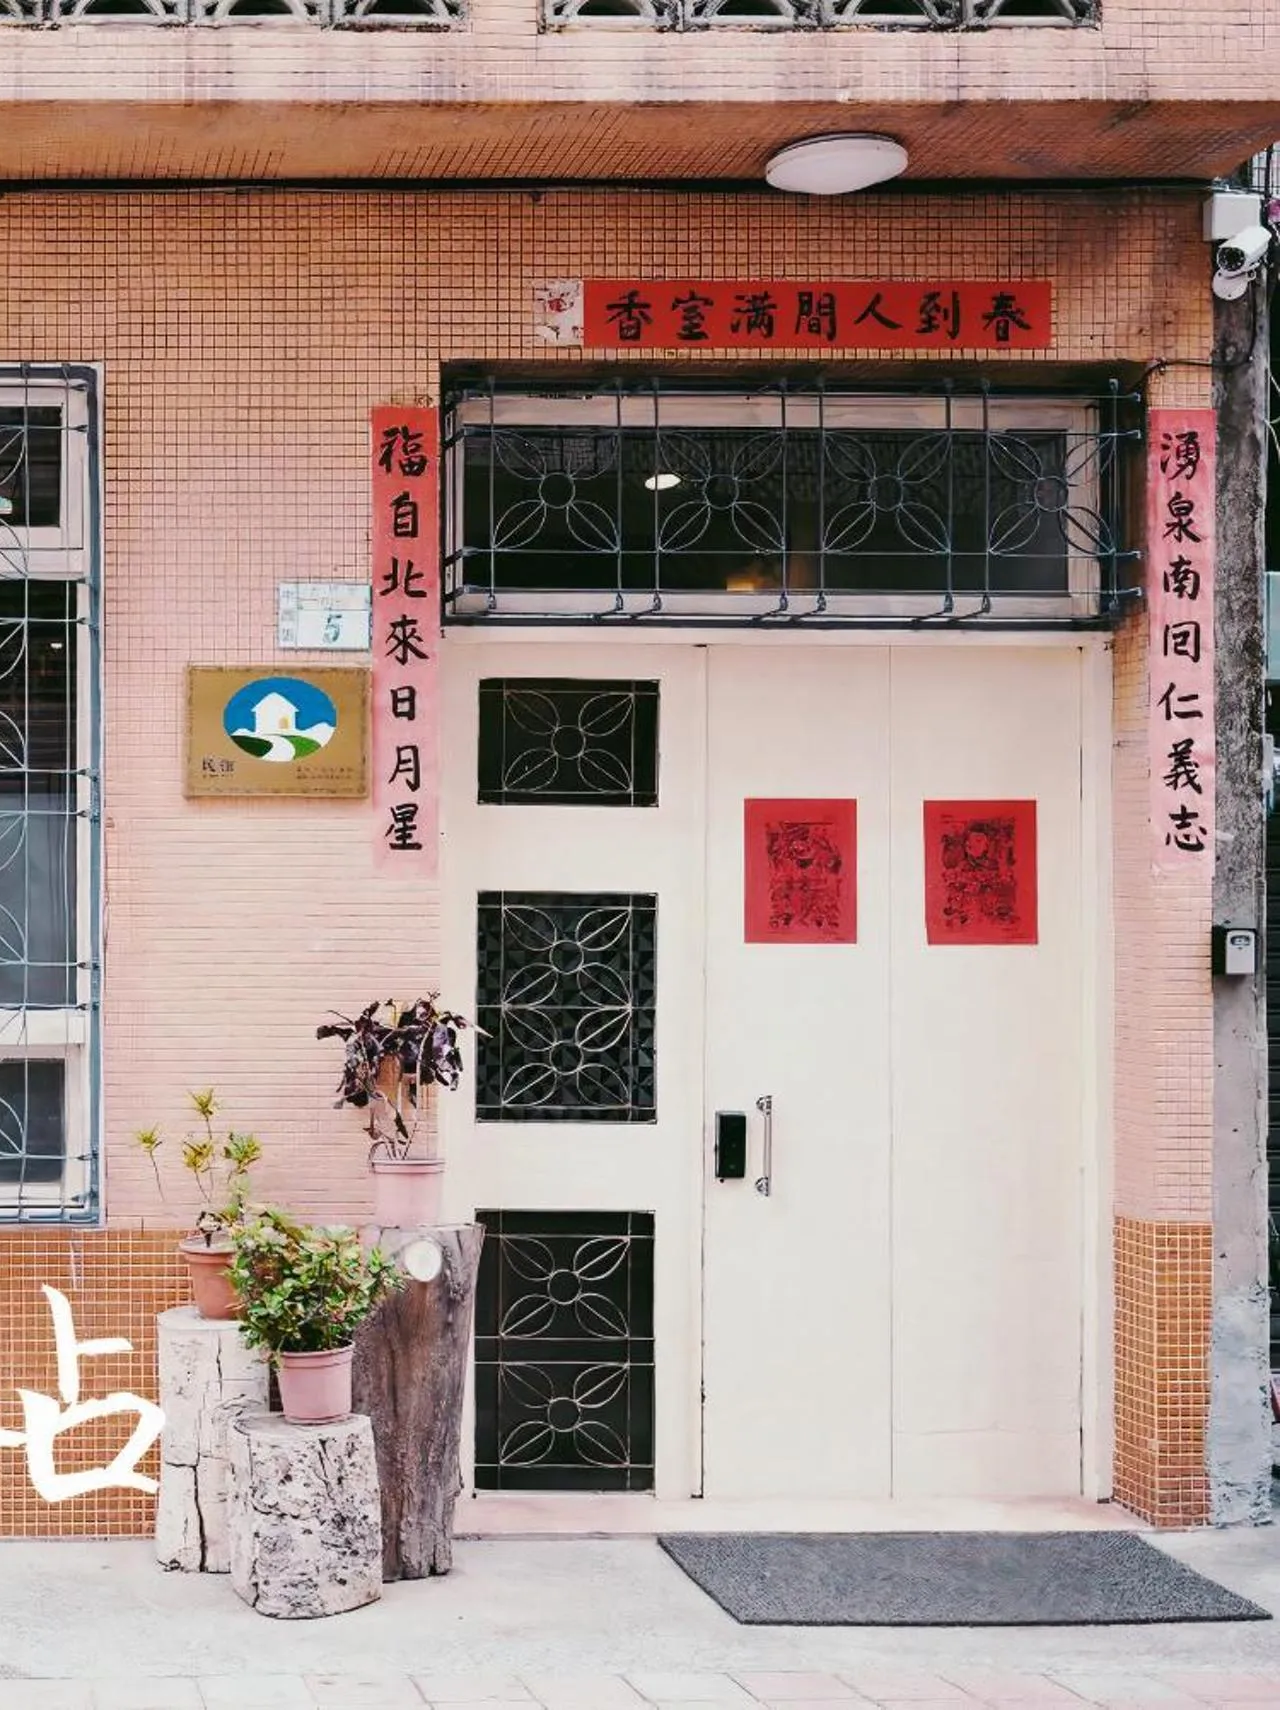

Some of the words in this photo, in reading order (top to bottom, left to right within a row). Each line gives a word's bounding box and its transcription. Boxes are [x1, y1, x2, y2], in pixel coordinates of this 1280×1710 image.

[379, 426, 428, 851] 福自北來日月星
